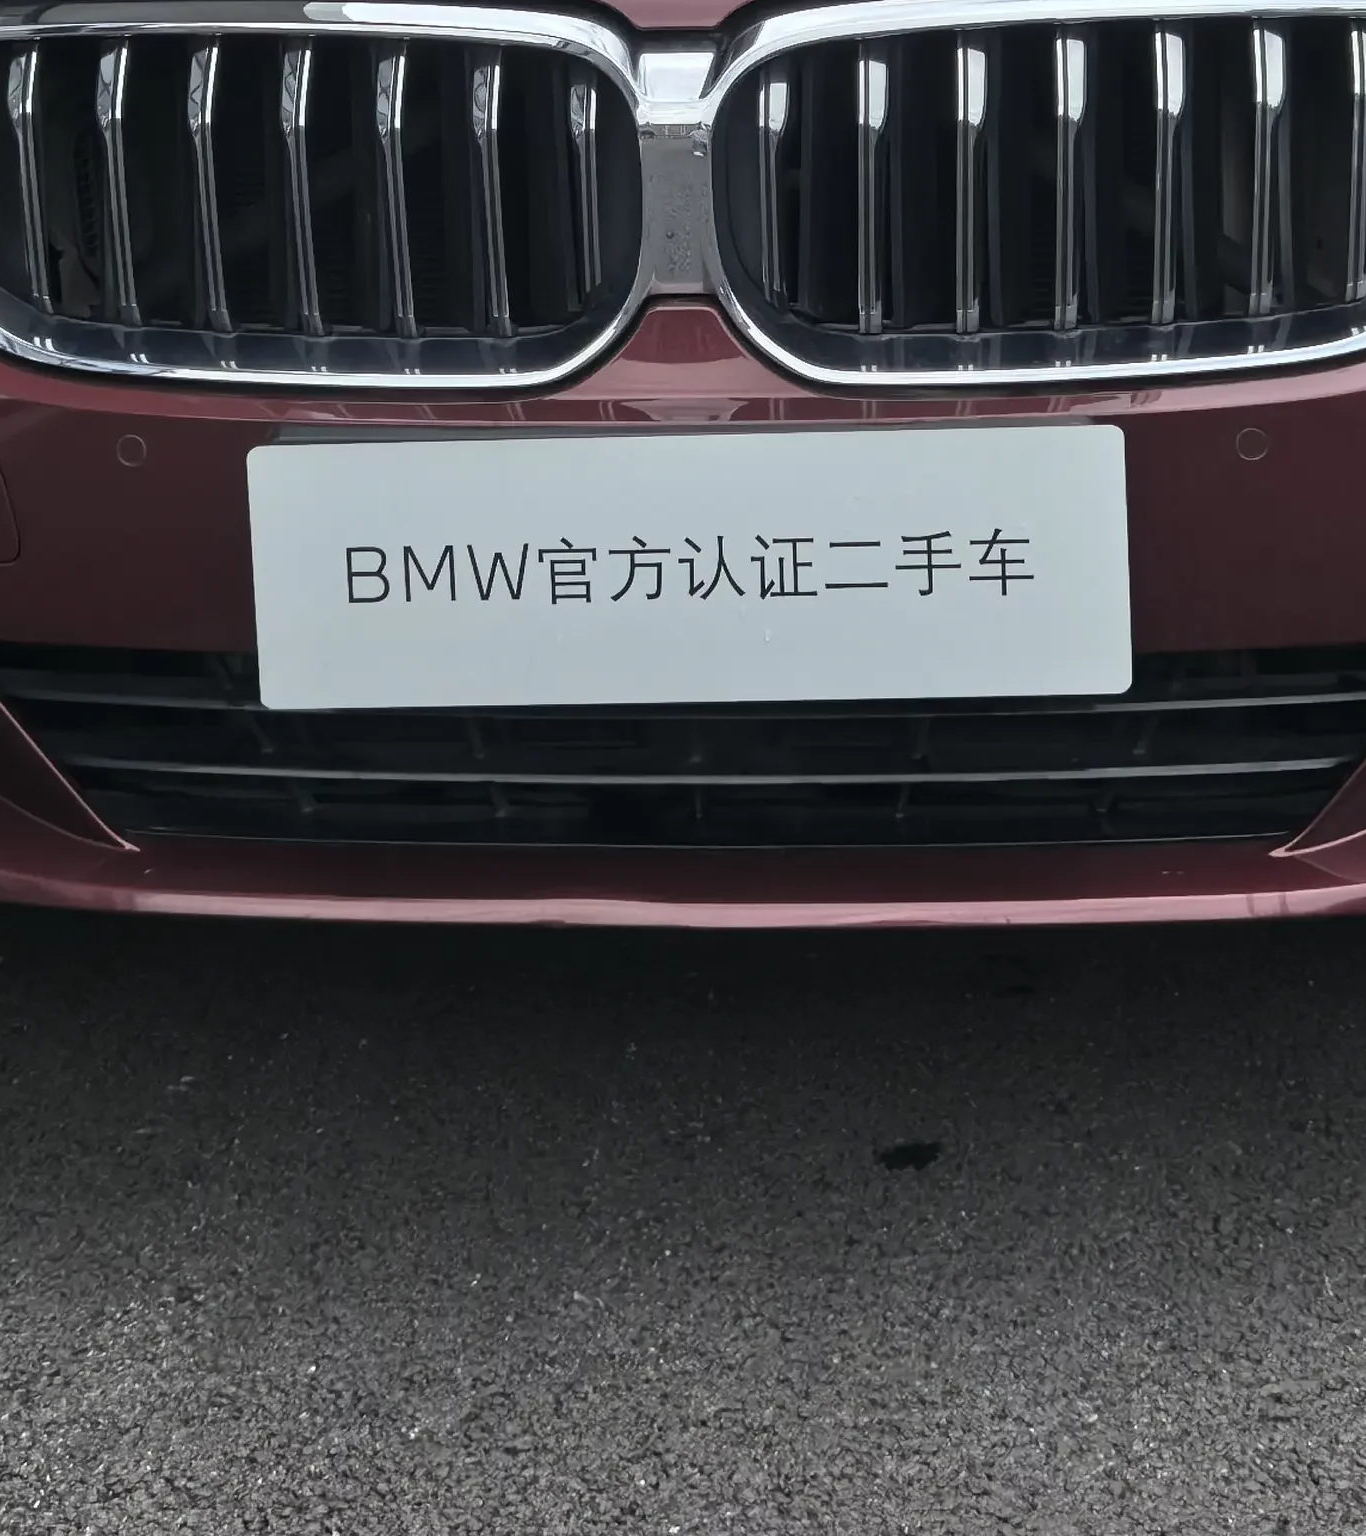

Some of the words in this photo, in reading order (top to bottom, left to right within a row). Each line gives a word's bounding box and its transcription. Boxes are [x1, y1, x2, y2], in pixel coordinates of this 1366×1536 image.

[344, 528, 1036, 605] BMW官方认证二手车
